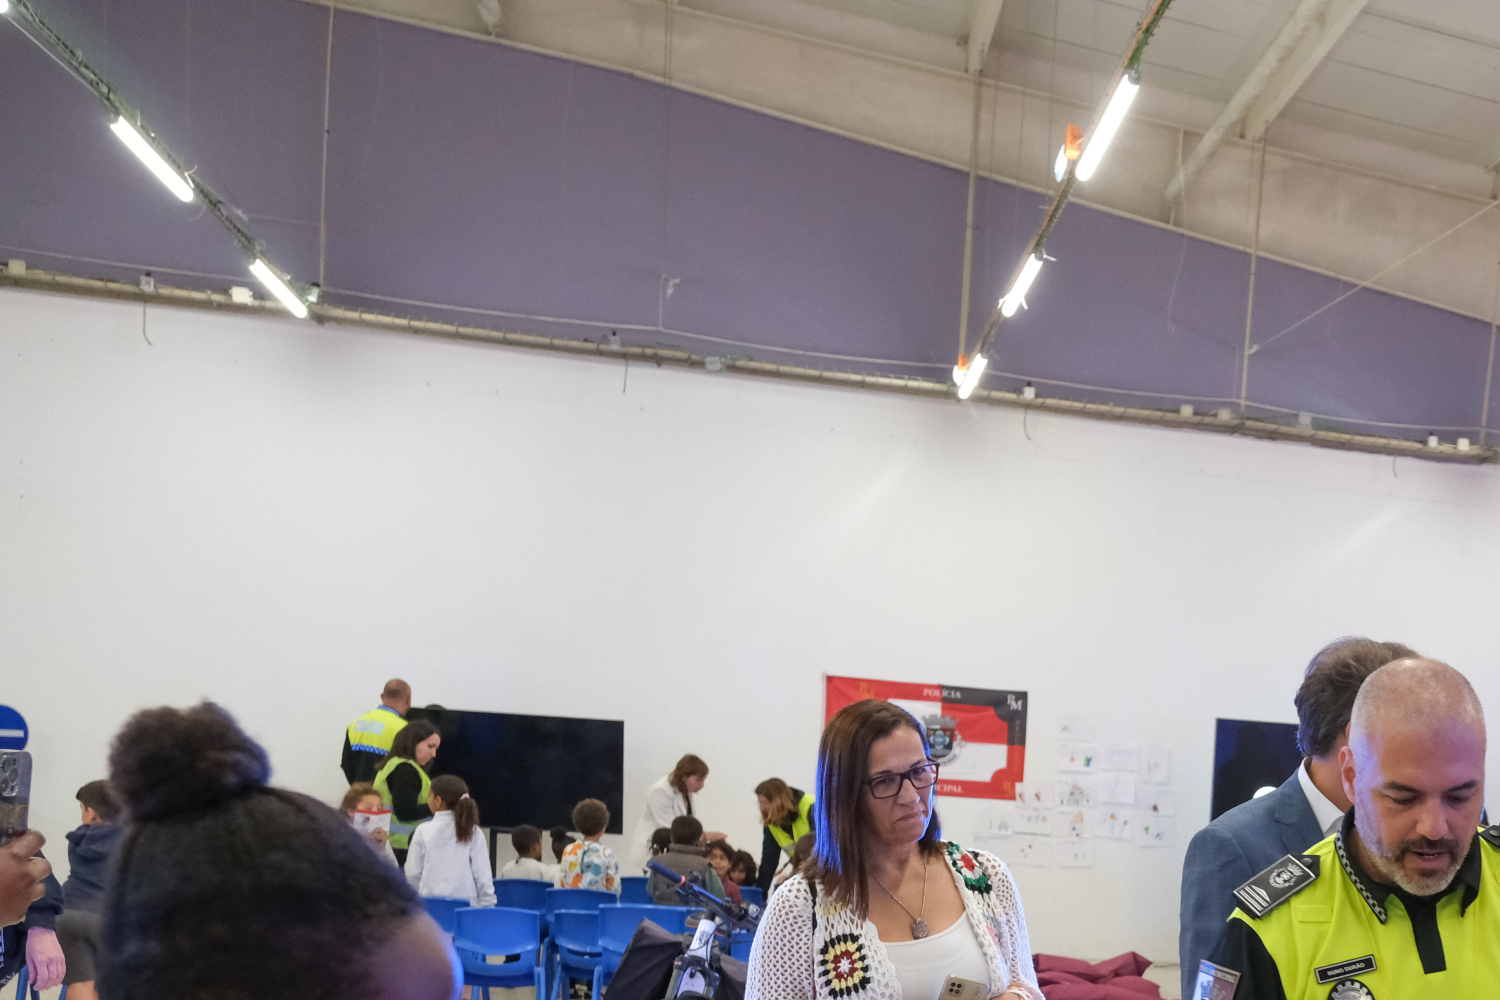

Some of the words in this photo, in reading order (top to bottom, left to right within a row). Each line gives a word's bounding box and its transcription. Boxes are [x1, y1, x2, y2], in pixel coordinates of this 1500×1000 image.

[923, 687, 962, 700] POLÍCIA
[1327, 967, 1344, 976] NUNO
[1344, 962, 1366, 972] DURÃO
